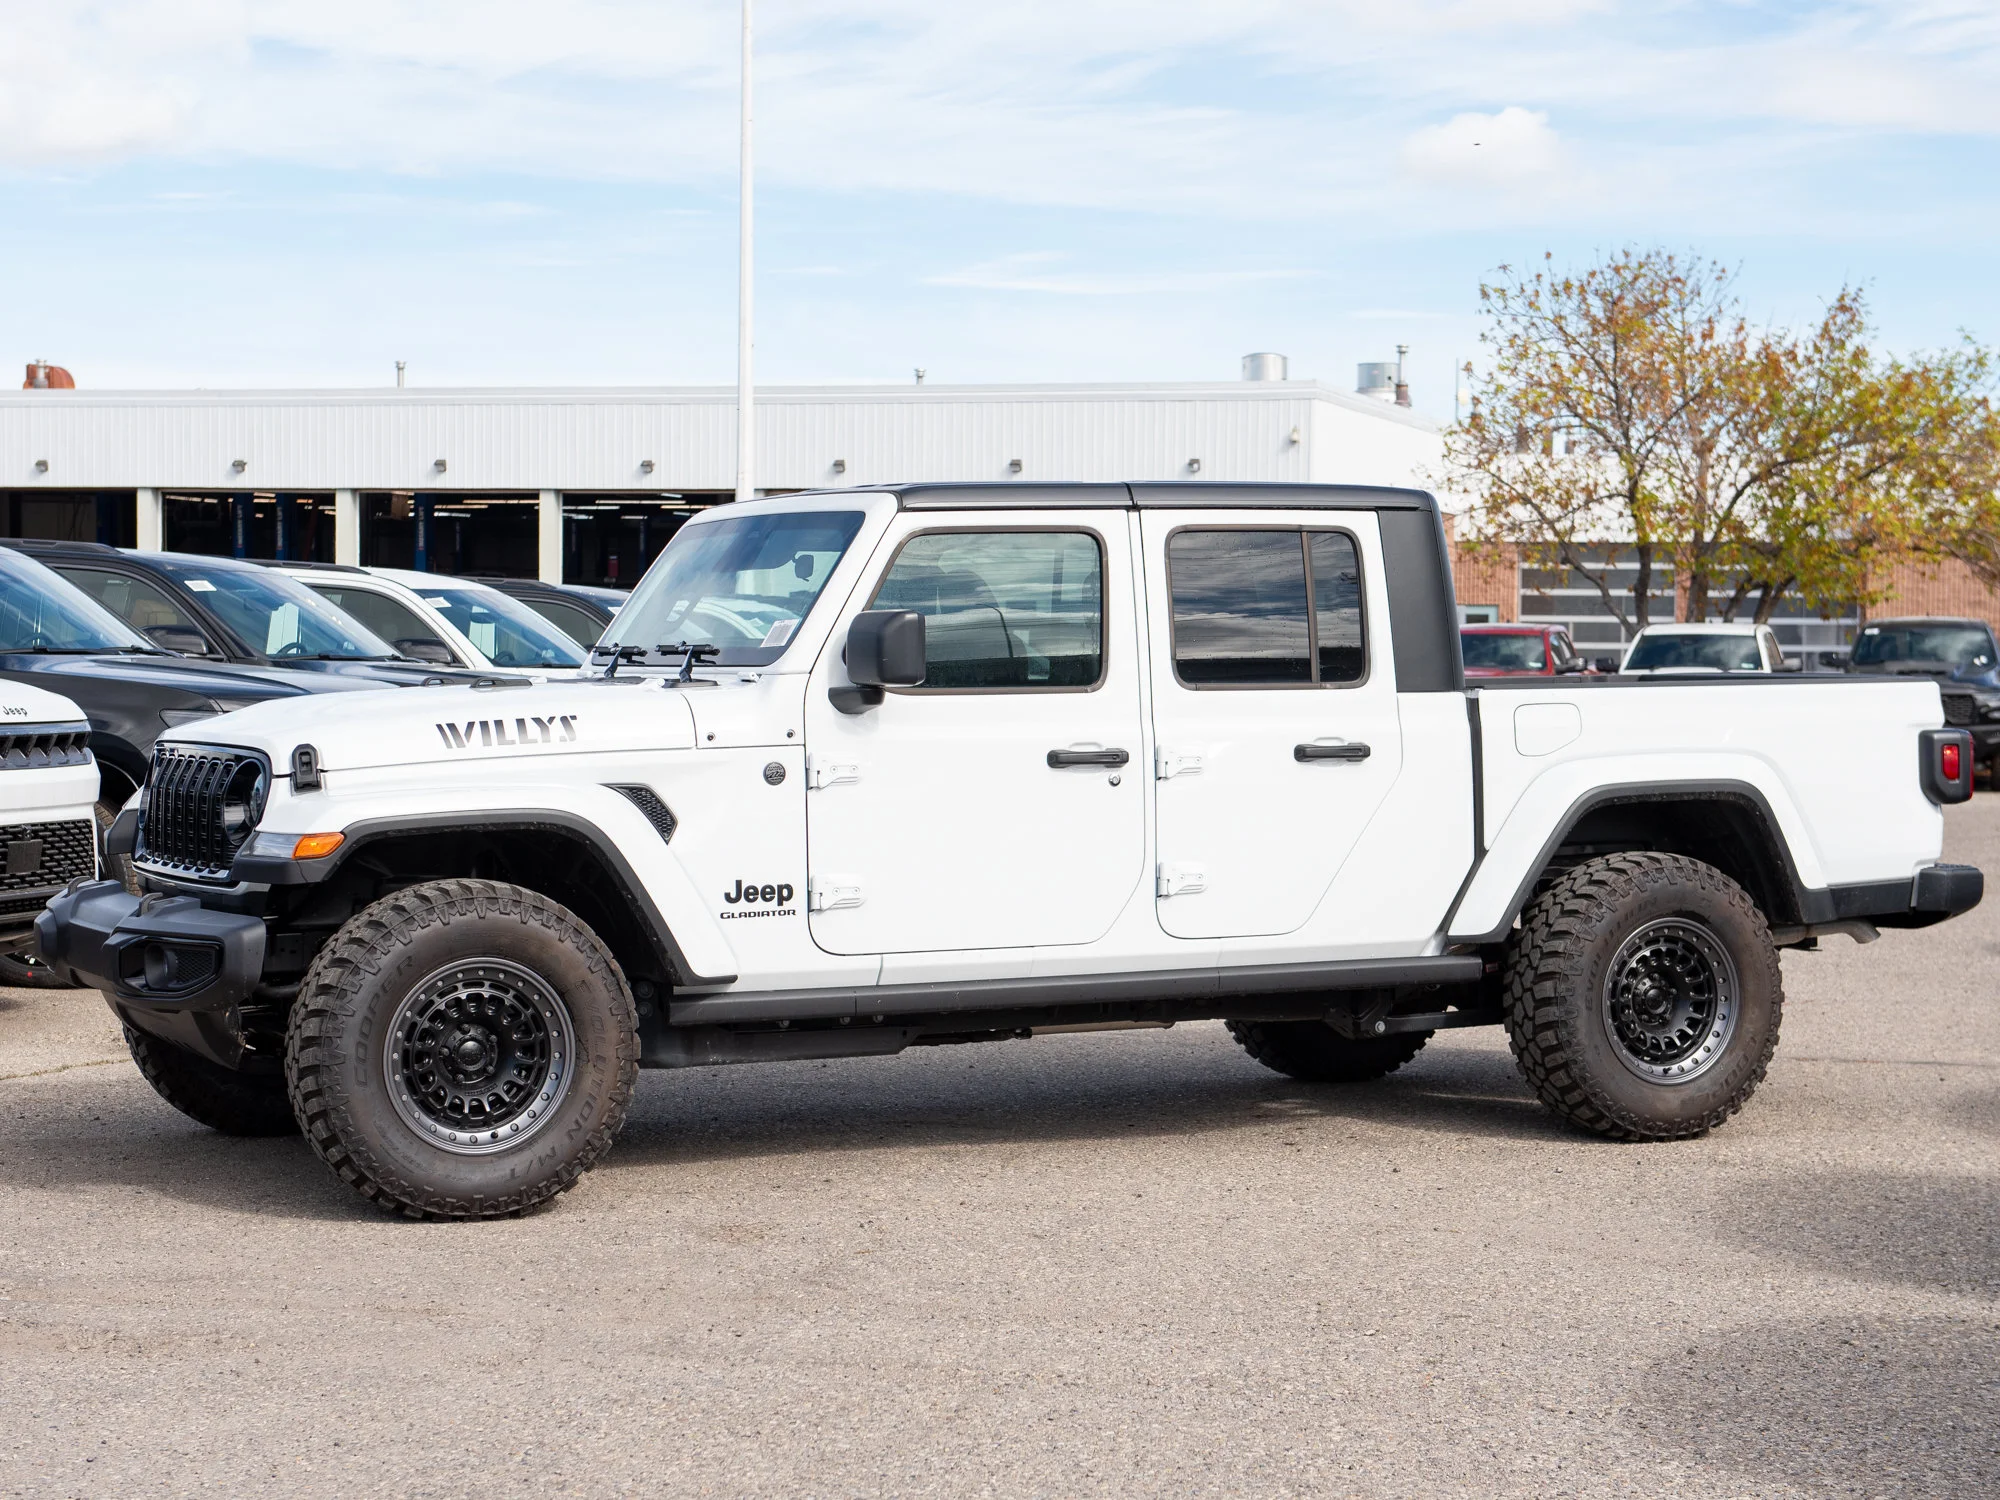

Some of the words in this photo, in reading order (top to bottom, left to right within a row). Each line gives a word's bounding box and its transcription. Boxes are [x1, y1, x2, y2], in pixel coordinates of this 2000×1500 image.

[2, 705, 28, 717] Jeep
[435, 714, 578, 749] WILLYS
[724, 879, 794, 906] Jeep
[719, 909, 797, 920] GLADIATOR
[354, 955, 414, 1088] COOPER
